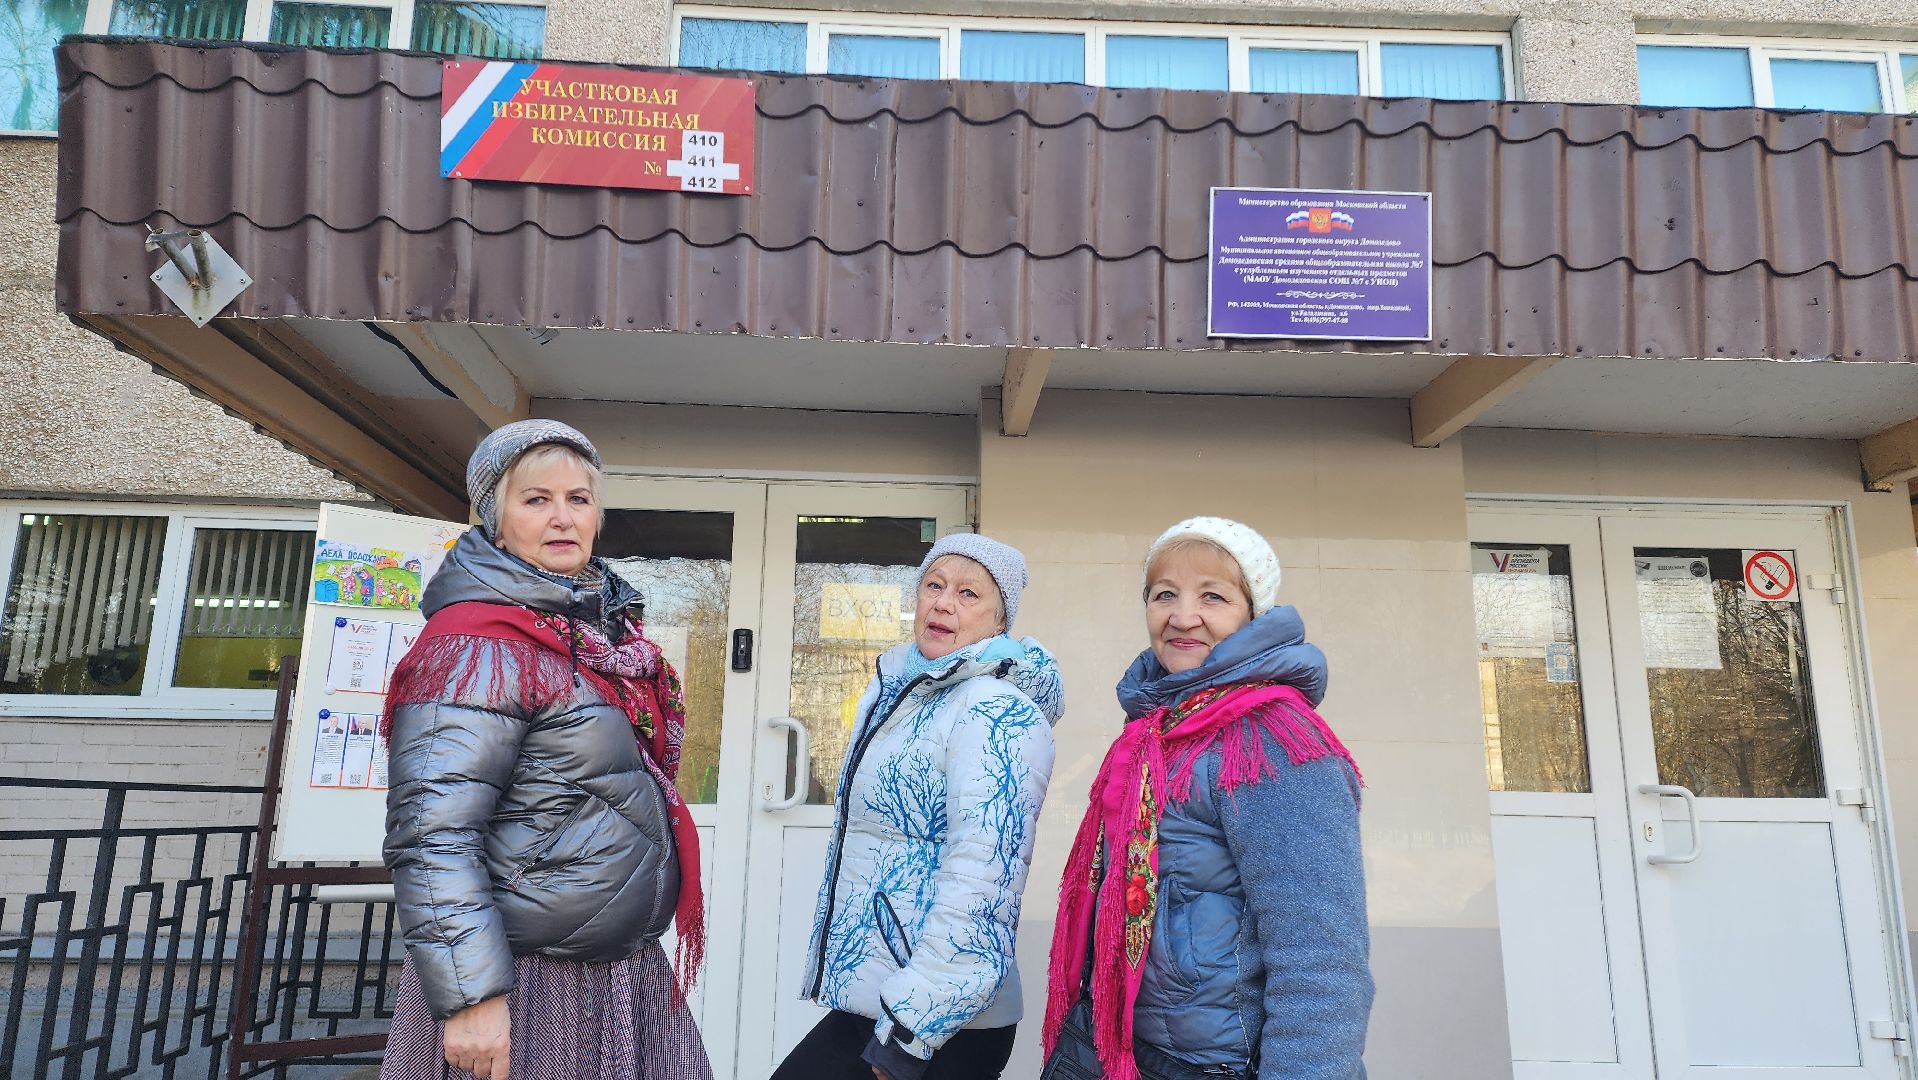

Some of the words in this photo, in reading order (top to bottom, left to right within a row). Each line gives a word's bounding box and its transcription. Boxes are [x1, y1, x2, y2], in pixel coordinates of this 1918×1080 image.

[520, 78, 678, 106] УЧАСТКОВАЯ
[491, 101, 700, 130] ИЗБИРАТЕЛЬНАЯ
[531, 127, 667, 152] КОМИССИЯ
[688, 134, 718, 147] 410
[644, 161, 662, 175] №
[688, 155, 716, 168] 411
[688, 176, 717, 189] 412
[1238, 198, 1289, 208] Министерство
[1335, 200, 1378, 209] Московской
[1244, 274, 1272, 284] (МАОУ
[1328, 277, 1350, 285] СОШ
[828, 598, 894, 622] ВХОД
